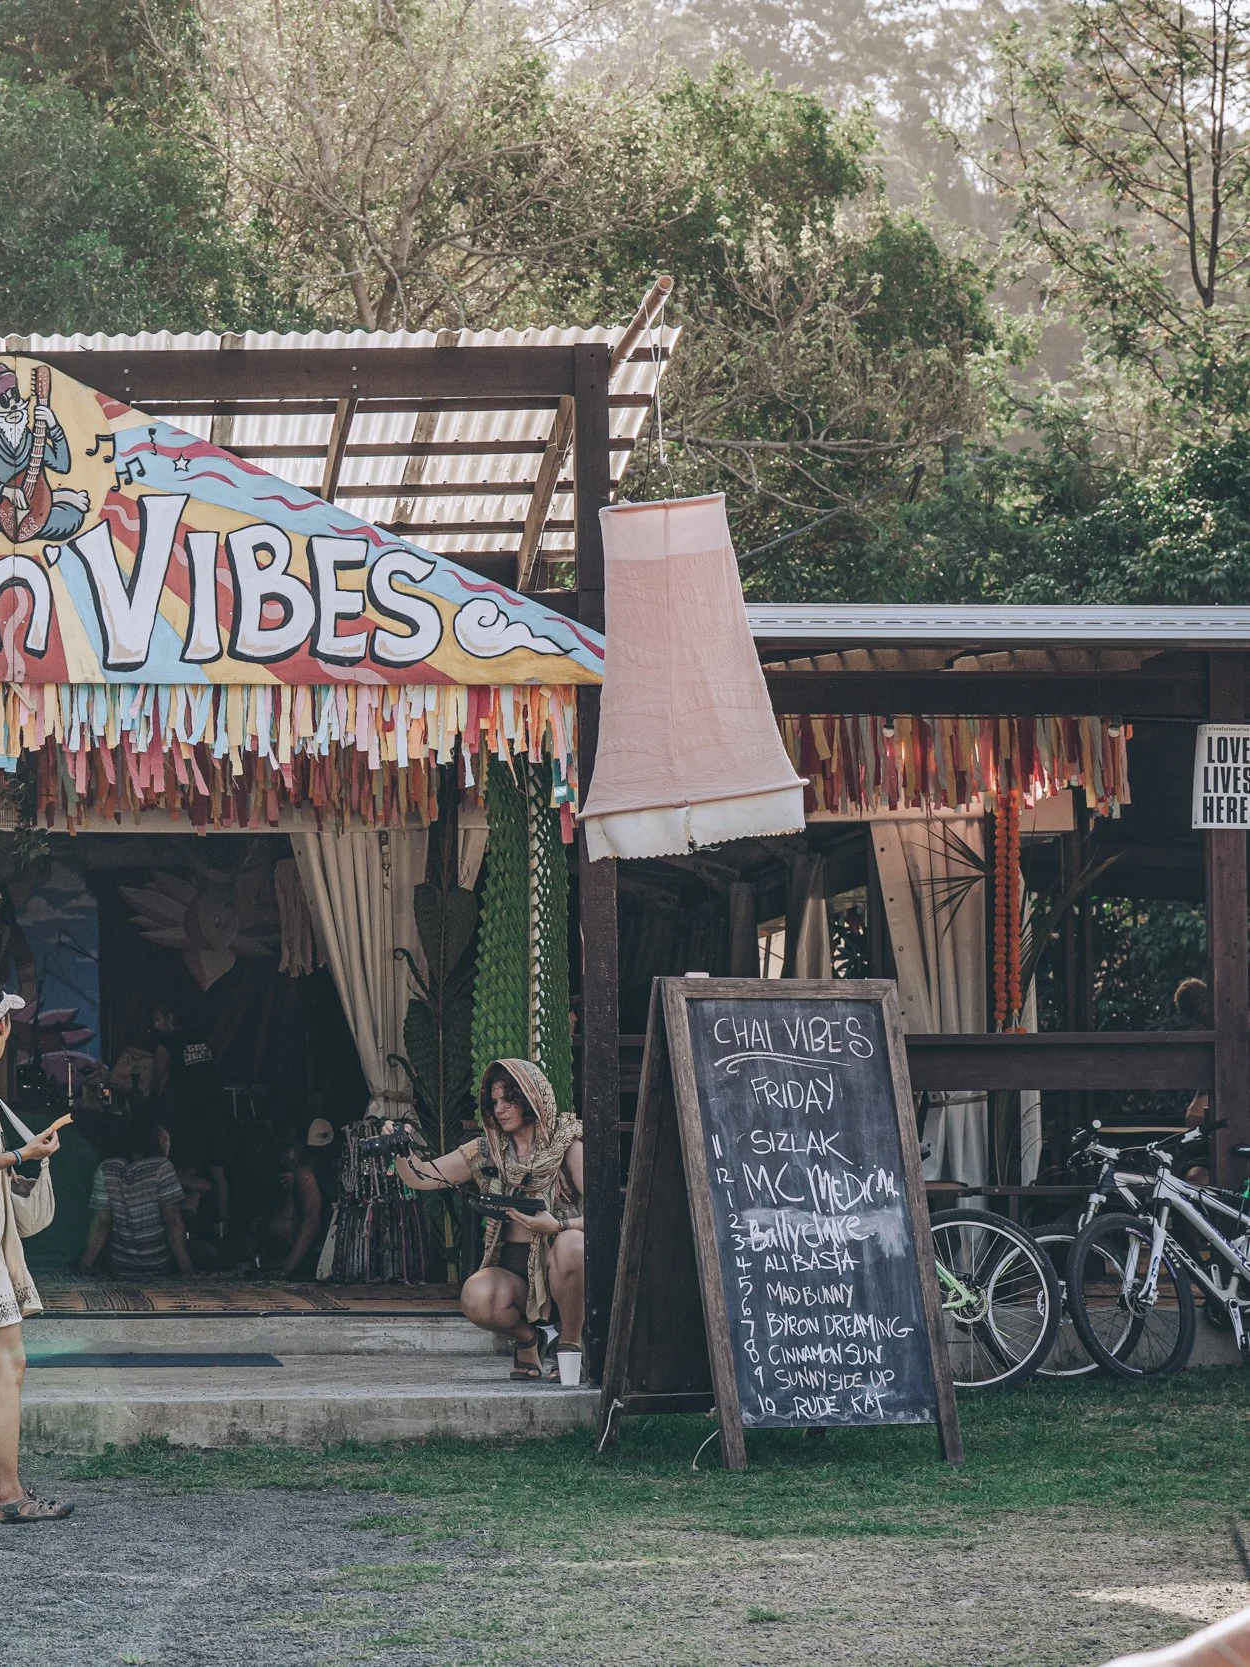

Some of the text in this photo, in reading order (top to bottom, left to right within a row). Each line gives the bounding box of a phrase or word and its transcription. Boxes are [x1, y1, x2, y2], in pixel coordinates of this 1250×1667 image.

[67, 494, 442, 671] VIBES
[1207, 736, 1250, 764] LOVE
[1203, 766, 1250, 795] LIVES
[1202, 796, 1248, 824] HERE
[714, 1016, 874, 1058] CHAI VIBES
[751, 1073, 834, 1114] FRIDAY
[750, 1130, 854, 1165] SIZLAK
[742, 1162, 805, 1204] MC
[728, 1213, 744, 1229] 2
[731, 1234, 746, 1251] 3
[736, 1255, 752, 1275] 4
[791, 1247, 862, 1276] BASTA
[738, 1275, 853, 1308] 5 MAD BUNNY
[741, 1297, 752, 1316] 6
[741, 1311, 914, 1342] 7 BYRON DREAMING
[744, 1339, 883, 1365] 8 CINNAMON SUN
[754, 1366, 764, 1388] 9
[870, 1370, 895, 1387] UP
[758, 1392, 886, 1419] 10 RUDE KAT
